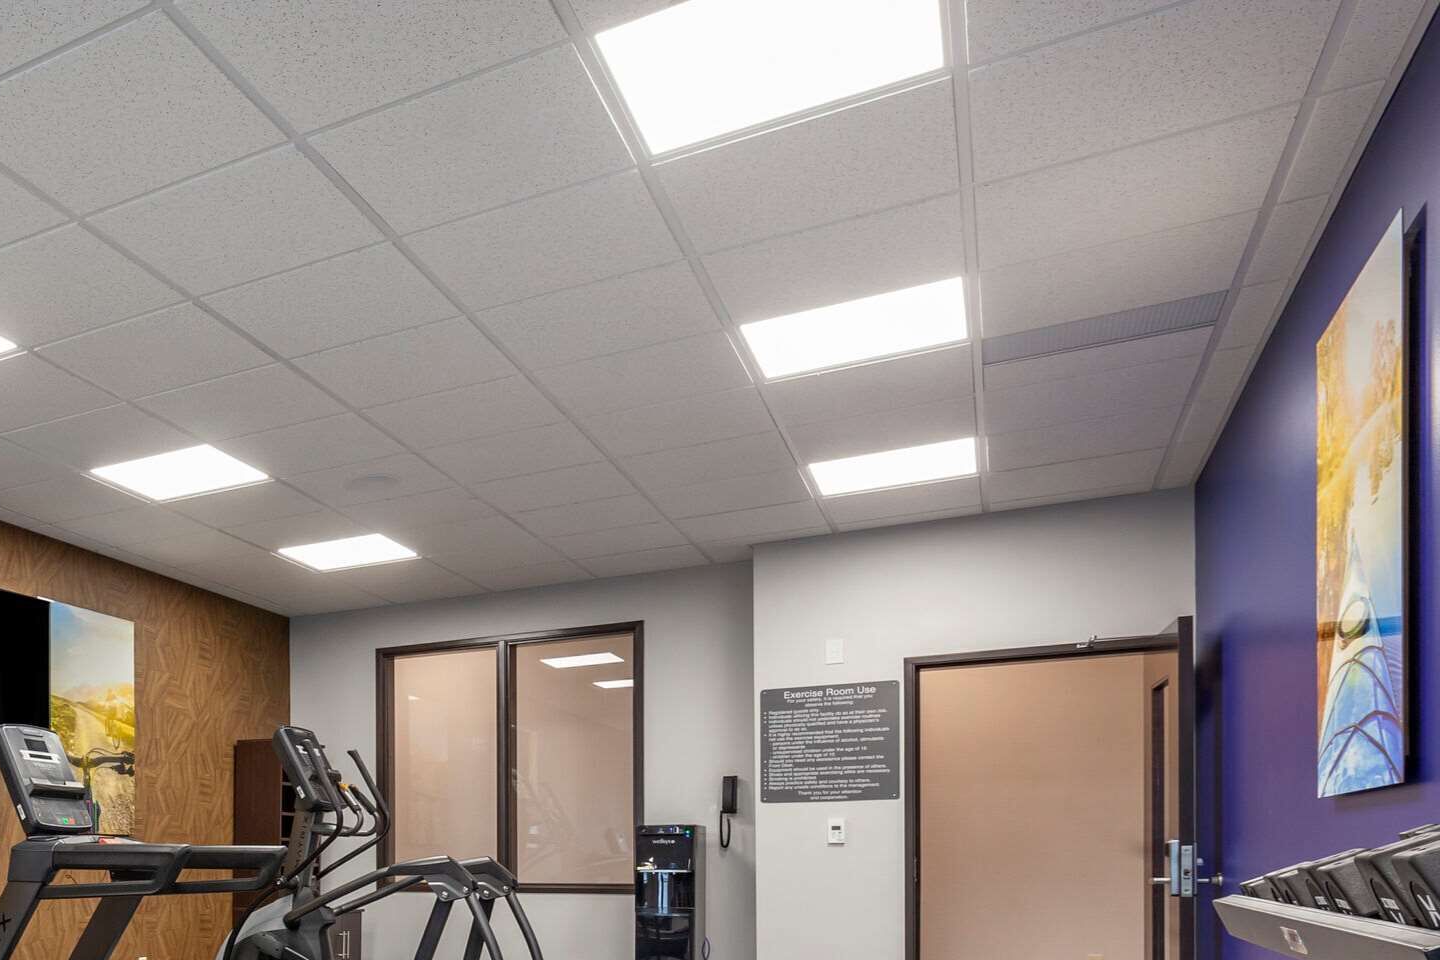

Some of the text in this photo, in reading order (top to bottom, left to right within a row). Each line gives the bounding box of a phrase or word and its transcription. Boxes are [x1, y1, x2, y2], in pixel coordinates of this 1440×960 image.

[783, 686, 876, 700] Exercise Room Use
